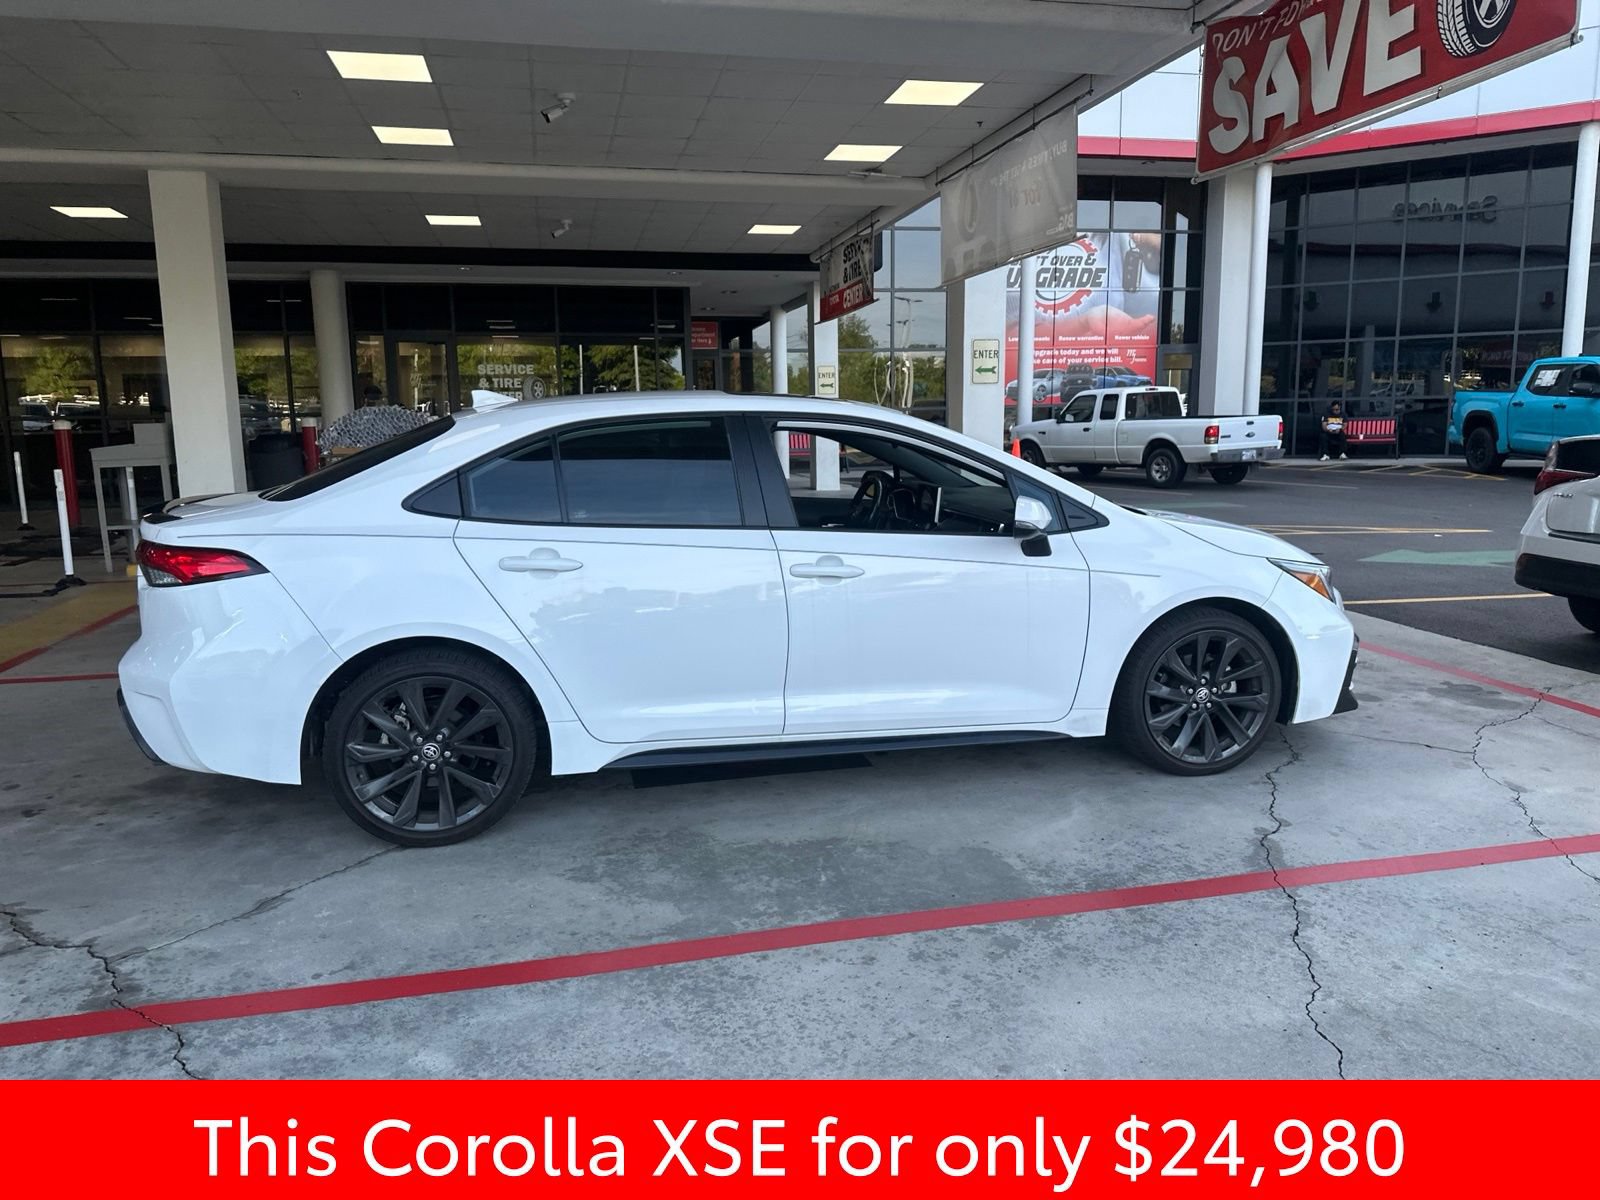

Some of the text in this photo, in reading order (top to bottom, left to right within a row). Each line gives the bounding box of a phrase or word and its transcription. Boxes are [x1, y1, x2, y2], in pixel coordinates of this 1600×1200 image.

[1208, 0, 1423, 154] SAVE
[1050, 255, 1083, 266] OVER
[1084, 252, 1096, 266] &
[1006, 267, 1107, 288] UGRADE
[973, 349, 999, 359] ENTER
[1060, 349, 1079, 357] today
[1067, 357, 1083, 365] your
[477, 364, 534, 375] SERVICE
[479, 378, 522, 388] & TIRE
